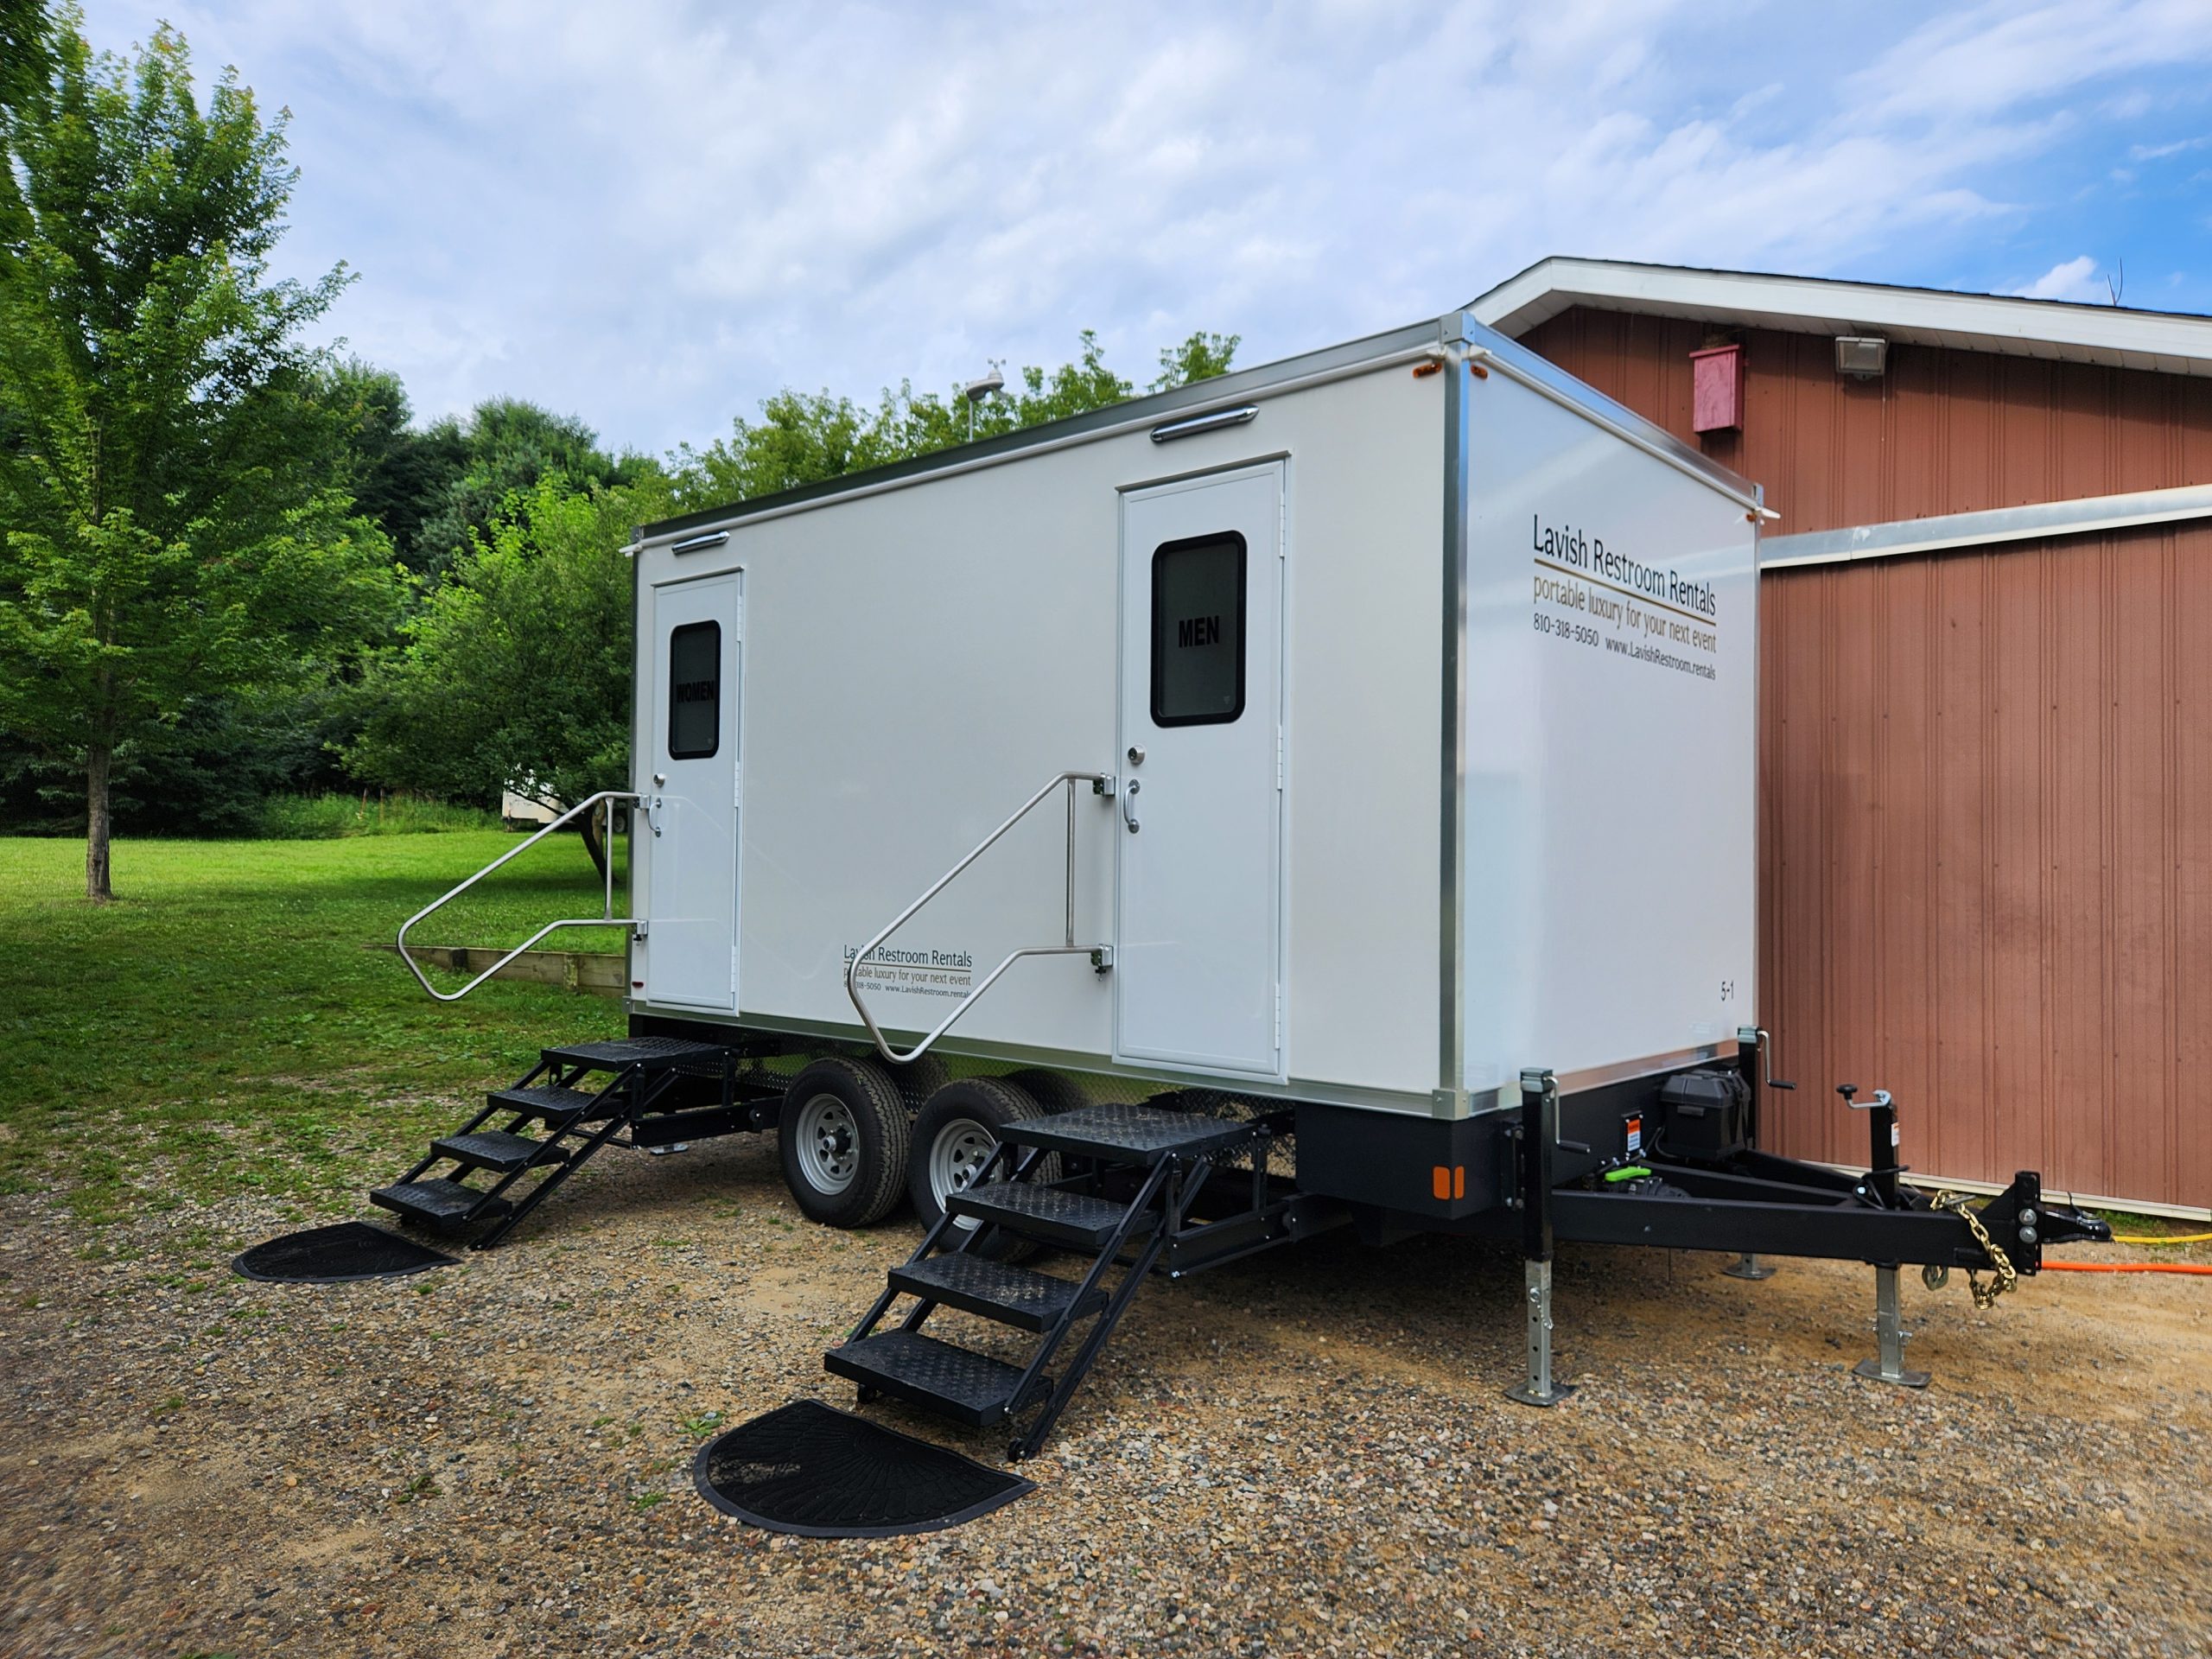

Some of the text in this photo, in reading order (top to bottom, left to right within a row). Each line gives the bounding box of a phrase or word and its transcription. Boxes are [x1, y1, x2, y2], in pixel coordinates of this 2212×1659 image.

[1533, 513, 1716, 616] Lavish Restroom Rentals
[1533, 575, 1716, 654] portable luxury for your next event
[1178, 614, 1220, 649] MEN
[1533, 613, 1716, 681] 810-318-5050 www.LavishRestroom.rentals
[676, 680, 715, 704] WOMEN
[878, 946, 929, 964] Restroom
[931, 950, 972, 968] Rentals
[874, 968, 896, 983] luxury
[899, 969, 910, 981] for
[912, 973, 928, 984] your
[930, 974, 947, 984] next
[949, 975, 971, 986] event
[1720, 980, 1734, 1002] 5-1
